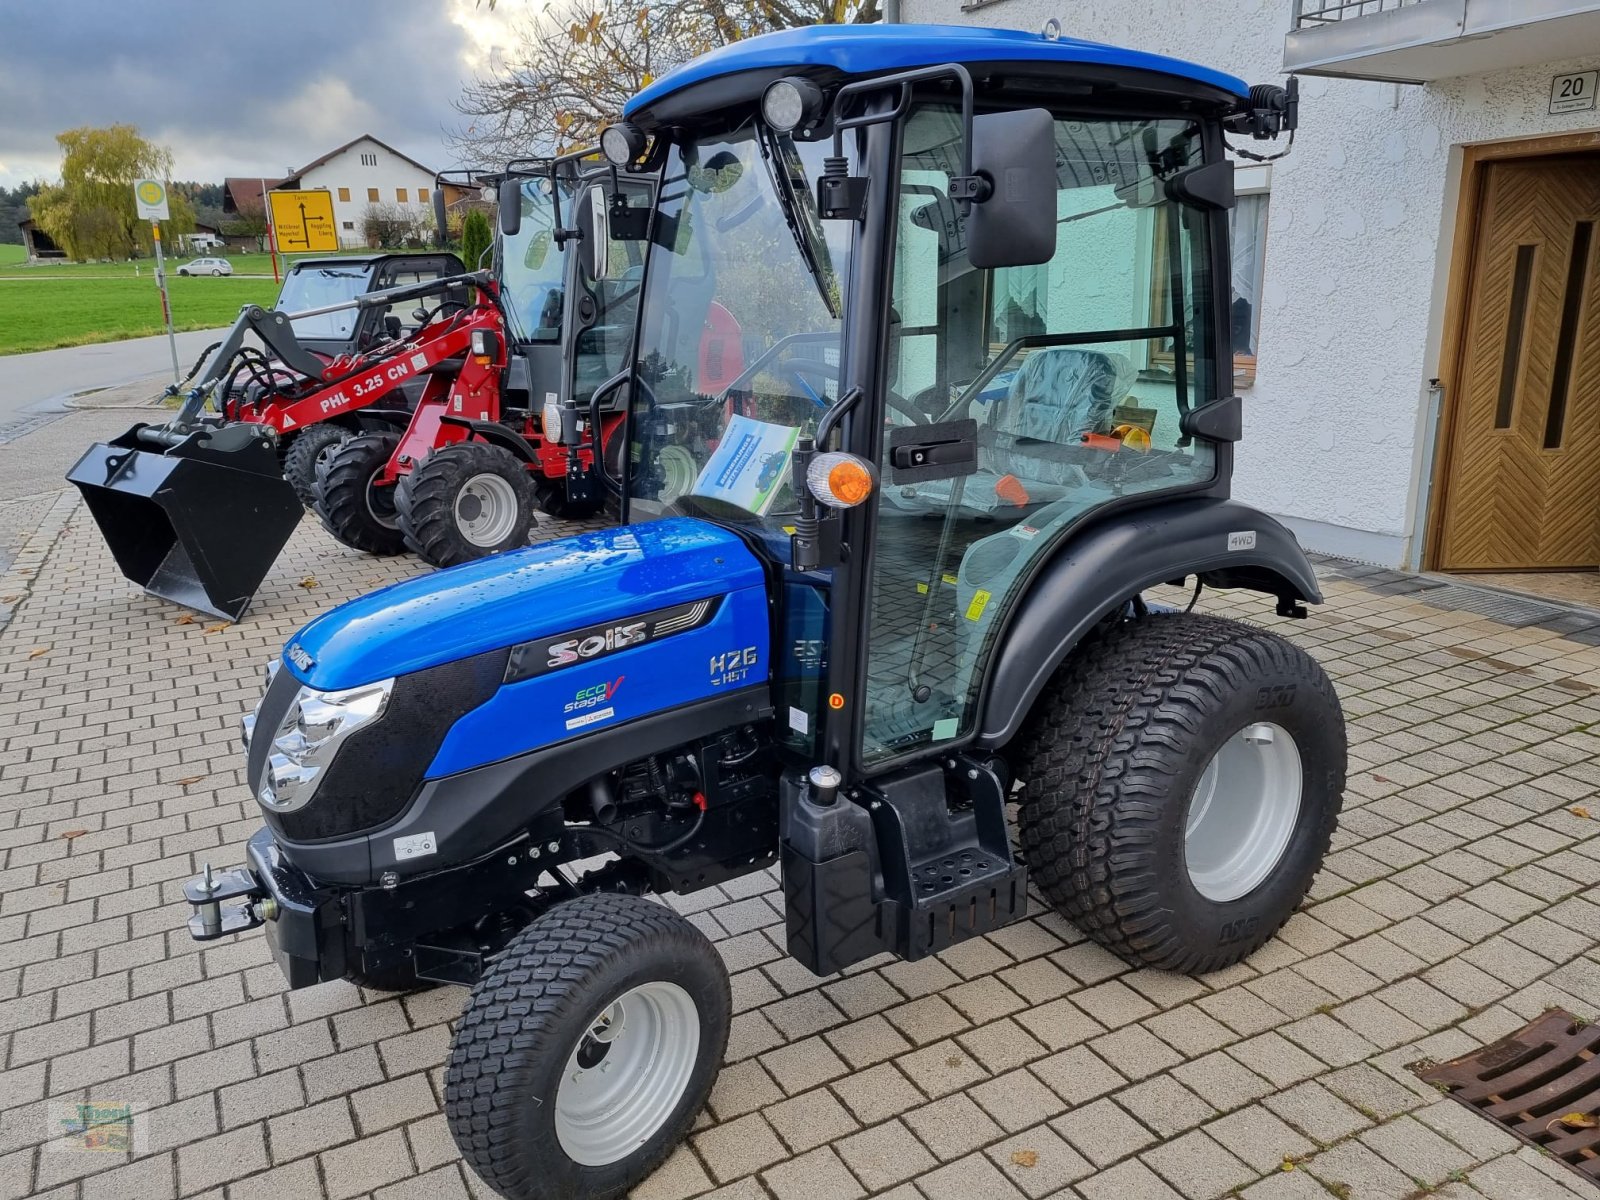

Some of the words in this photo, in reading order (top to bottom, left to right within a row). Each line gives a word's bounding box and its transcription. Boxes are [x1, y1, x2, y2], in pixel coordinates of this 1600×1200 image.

[1560, 77, 1584, 97] 20
[320, 392, 350, 413] PHL
[353, 374, 384, 397] 3.25
[387, 363, 408, 380] CN
[1231, 535, 1253, 546] 4WD
[710, 646, 757, 676] H26
[722, 668, 749, 684] HST
[1254, 684, 1297, 711] BKT
